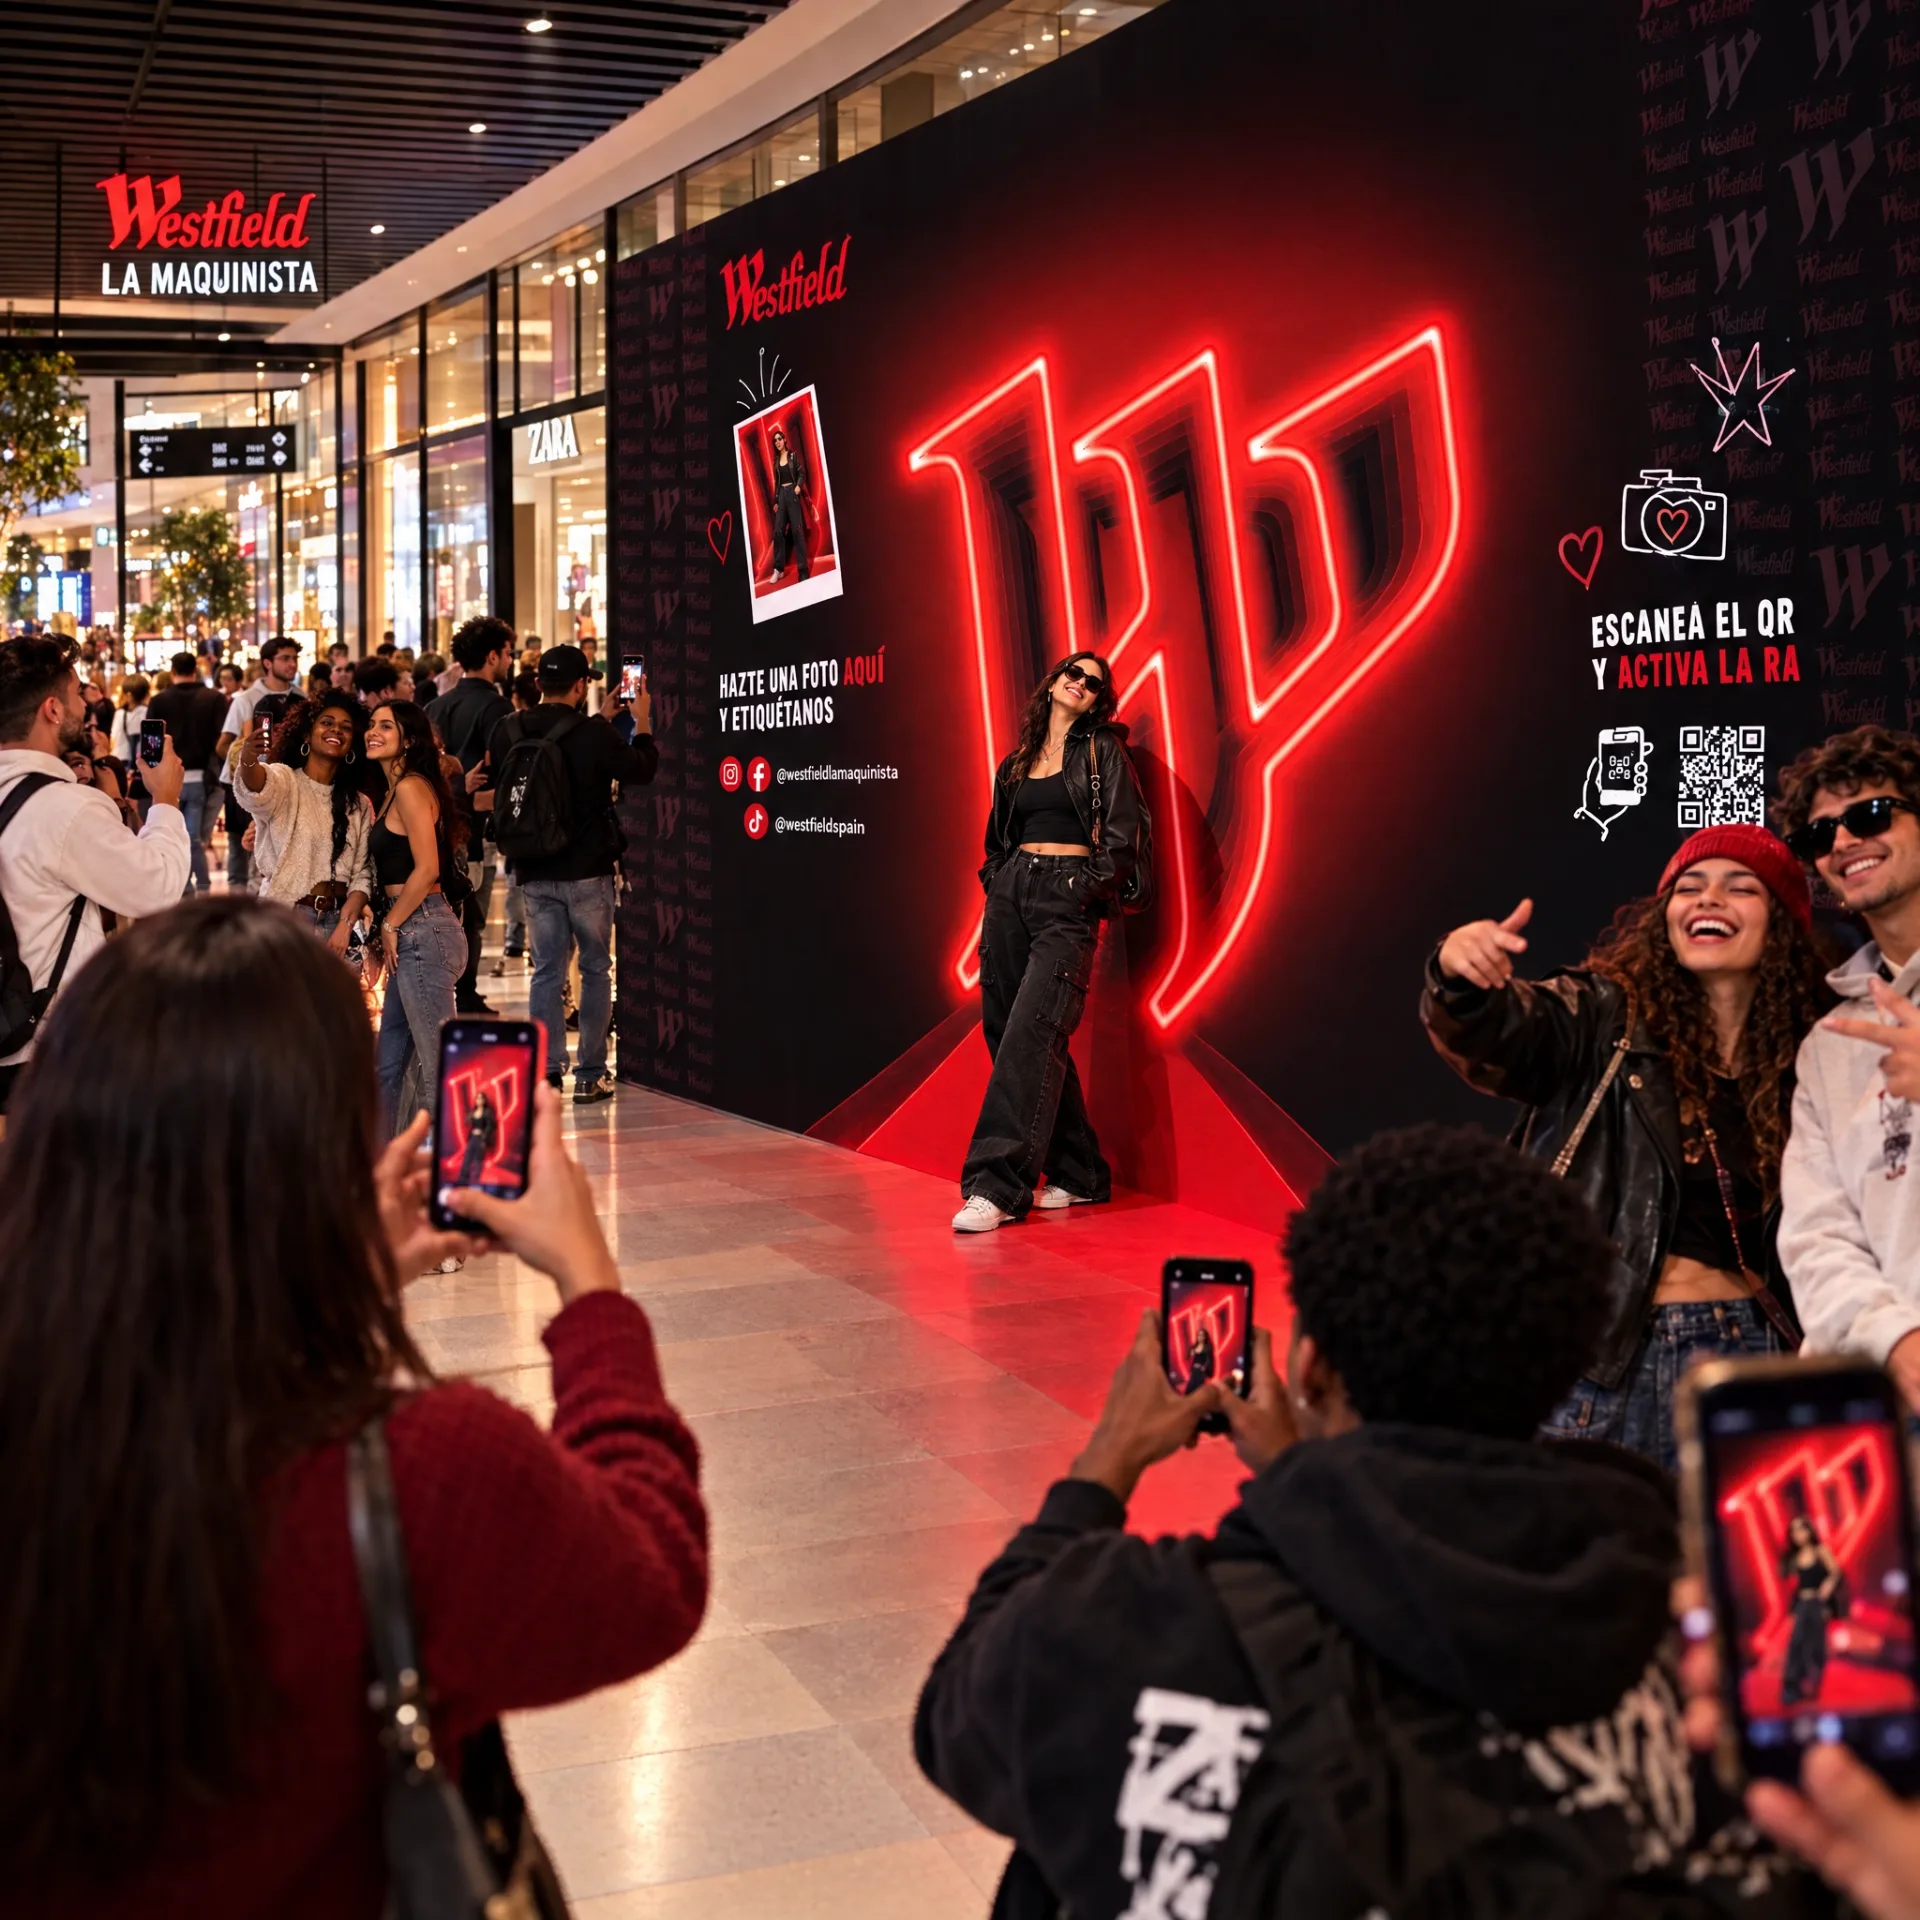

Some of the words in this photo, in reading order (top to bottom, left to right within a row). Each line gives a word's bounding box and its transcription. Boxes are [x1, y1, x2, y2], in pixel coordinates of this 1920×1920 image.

[96, 173, 317, 250] Westfield
[102, 262, 141, 295] LA
[151, 261, 319, 296] MAQUINISTA
[719, 233, 852, 331] Westfield
[528, 414, 580, 464] ZARA
[1716, 601, 1747, 639] EL
[1757, 597, 1795, 638] QR
[719, 670, 765, 699] HAZTE
[769, 665, 798, 693] UNA
[802, 659, 839, 689] FOTO
[843, 645, 886, 687] AQUÍ
[1591, 657, 1607, 690] Y
[1617, 650, 1709, 689] ACTIVA
[1719, 647, 1753, 684] LA
[1763, 645, 1800, 683] RA
[719, 707, 728, 733] Y
[732, 696, 834, 732] ETIQUÉTANOS
[776, 765, 899, 784] @westfieldlamaquinista
[775, 816, 865, 838] @westfieldspain
